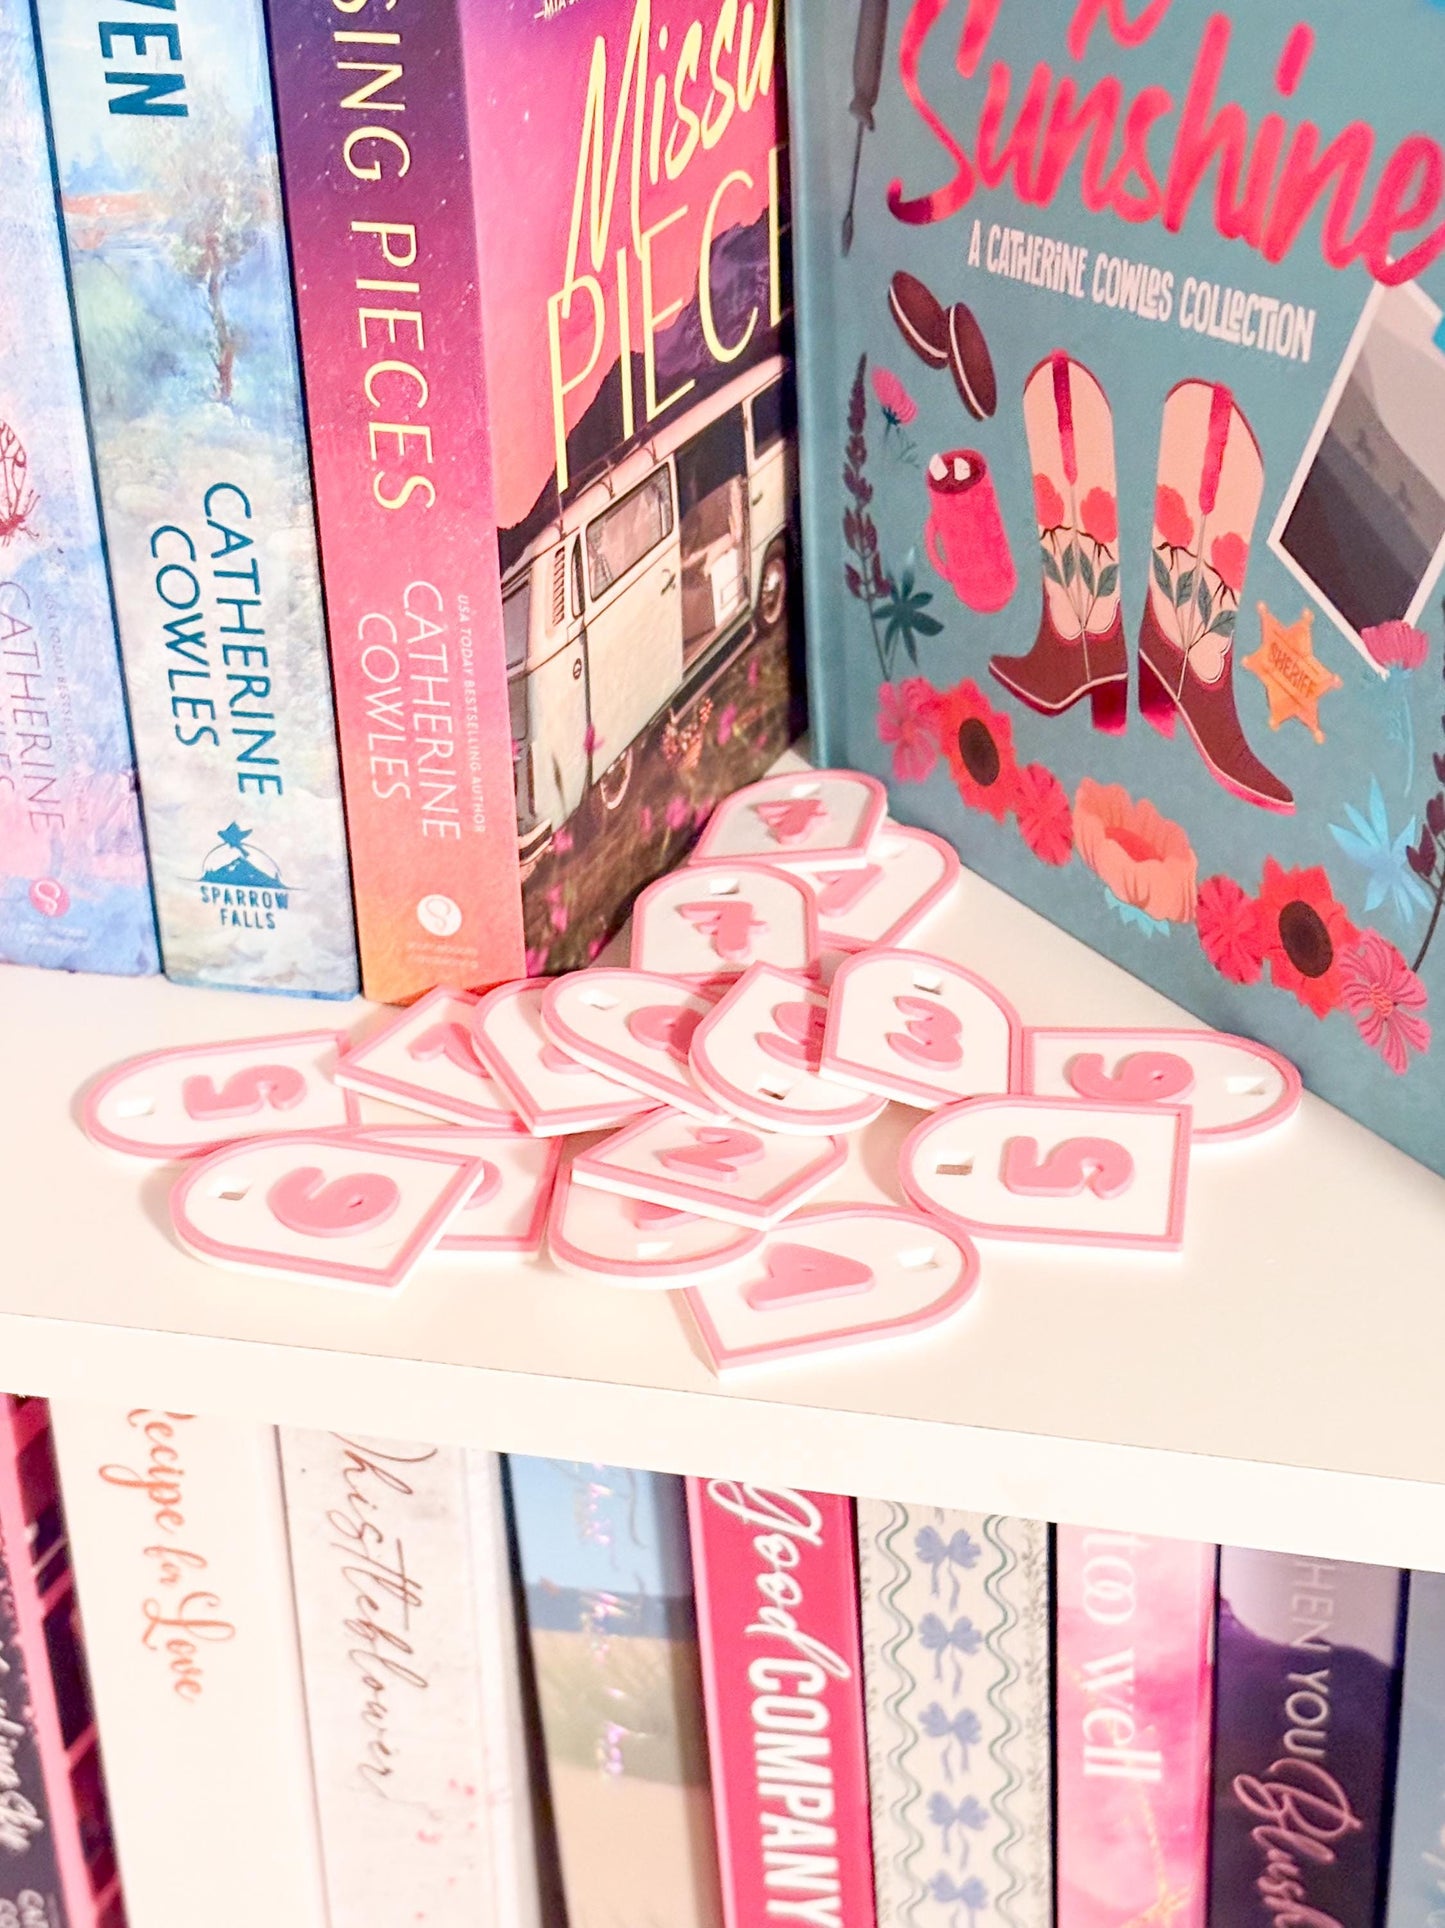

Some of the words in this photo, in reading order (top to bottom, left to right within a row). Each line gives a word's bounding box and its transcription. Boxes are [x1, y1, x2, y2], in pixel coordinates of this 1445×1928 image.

[98, 0, 188, 117] EN
[887, 0, 1445, 287] Sunshine
[967, 219, 982, 268] A
[351, 221, 436, 510] PIECES
[150, 525, 220, 748] COWLES
[203, 482, 283, 796] CATHERINE
[457, 594, 471, 624] USA
[460, 627, 475, 675] TODAY
[357, 612, 411, 800] COWLES
[402, 580, 461, 841] CATHERINE
[463, 680, 482, 773] BESTSELLING
[470, 776, 486, 834] AUTHOR
[200, 885, 289, 911] SPARROW
[220, 908, 277, 931] FALLS
[886, 995, 964, 1072] 3
[182, 1063, 309, 1122] 5
[1001, 1135, 1134, 1202] 5
[98, 1408, 197, 1535] ecipe
[143, 1545, 208, 1584] for
[707, 1479, 852, 1679] Good
[141, 1590, 236, 1704] Love
[1081, 1647, 1164, 1783] well
[1283, 1668, 1331, 1760] YOU
[748, 1656, 845, 1928] COMPANY
